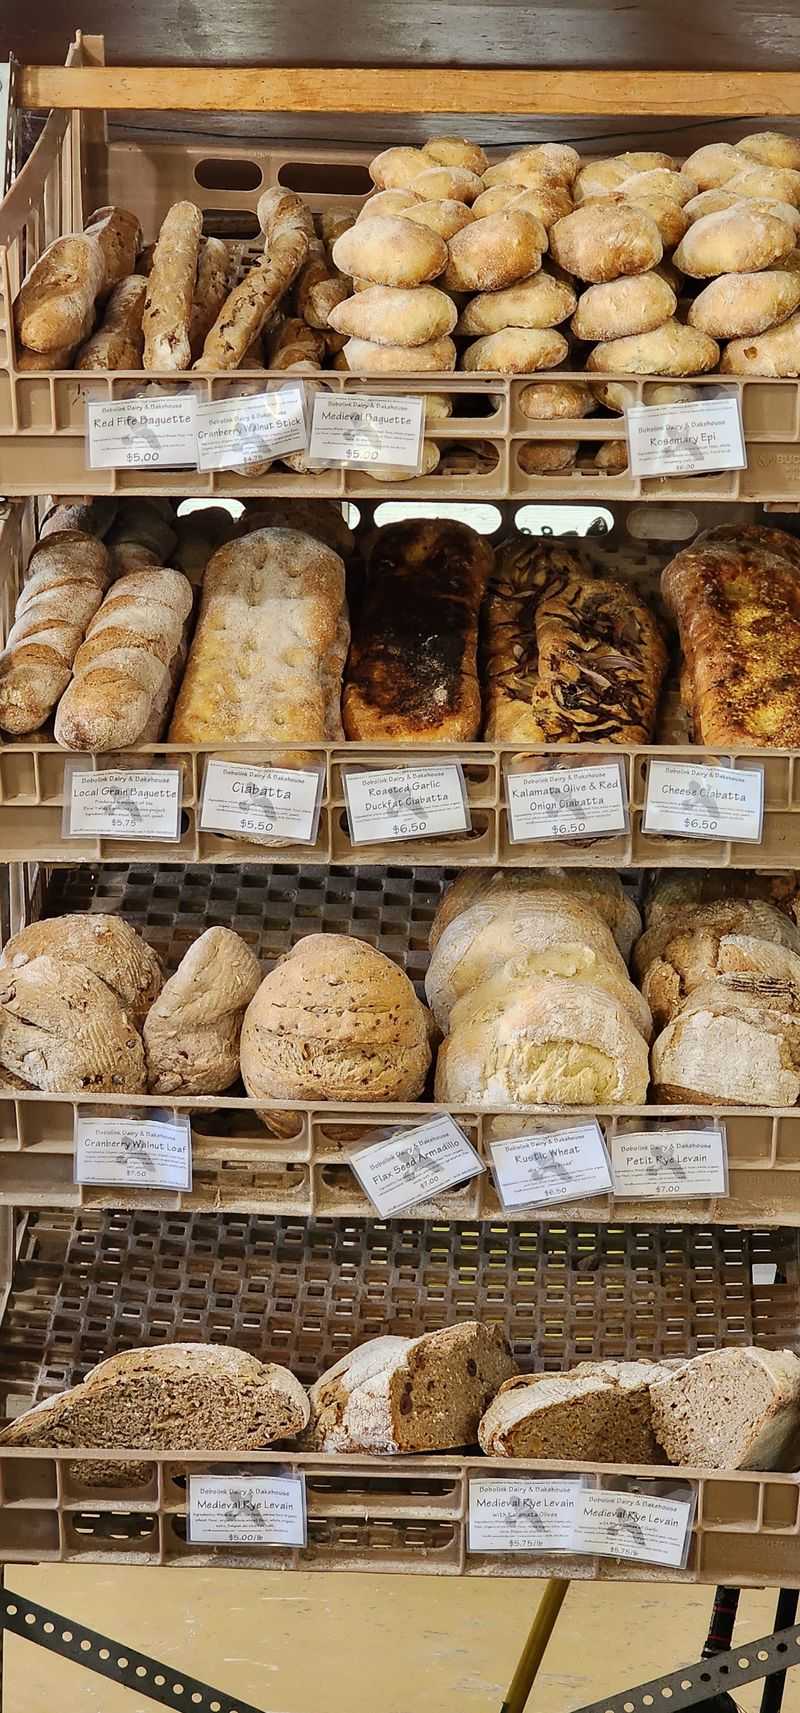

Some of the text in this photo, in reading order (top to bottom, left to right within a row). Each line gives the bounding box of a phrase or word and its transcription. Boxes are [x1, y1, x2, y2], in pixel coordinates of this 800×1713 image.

[94, 416, 191, 428] Red Fife Baguette
[321, 412, 412, 425] Medieval Baguette
[198, 427, 241, 439] Cranberry
[240, 422, 273, 432] Walnut
[276, 417, 302, 428] Stick
[649, 432, 716, 447] Rosemary Epi
[127, 452, 159, 462] $5.00
[345, 449, 378, 460] $5.00
[74, 787, 176, 799] Local Grain Baguette
[232, 781, 291, 800] Ciabatta
[369, 781, 441, 797] Roasted Garlic
[512, 787, 561, 798] Kalamata
[563, 784, 586, 793] Olive
[599, 781, 618, 789] Red
[662, 785, 746, 802] Cheese Ciabatta
[365, 793, 448, 811] Duckfat Ciabatta
[530, 797, 604, 811] Onion Ciabatta
[112, 819, 136, 827] $5.75
[240, 819, 274, 832] $5.50
[392, 822, 427, 834] $6.50
[552, 823, 586, 834] $6.50
[684, 818, 718, 830] $6.50
[84, 1139, 187, 1153] Cranberry Walnut Loaf
[514, 1146, 580, 1164] Rustic Wheat
[626, 1154, 707, 1167] Petit Rye Levain
[372, 1140, 460, 1184] Flax Seed Armadillo
[420, 1175, 439, 1189] $7.00
[197, 1500, 293, 1511] Medieval Rye Levain
[476, 1498, 575, 1509] Medieval Rye Levain
[583, 1508, 626, 1518] Medieval
[628, 1511, 646, 1522] Rye
[649, 1514, 678, 1527] Levain
